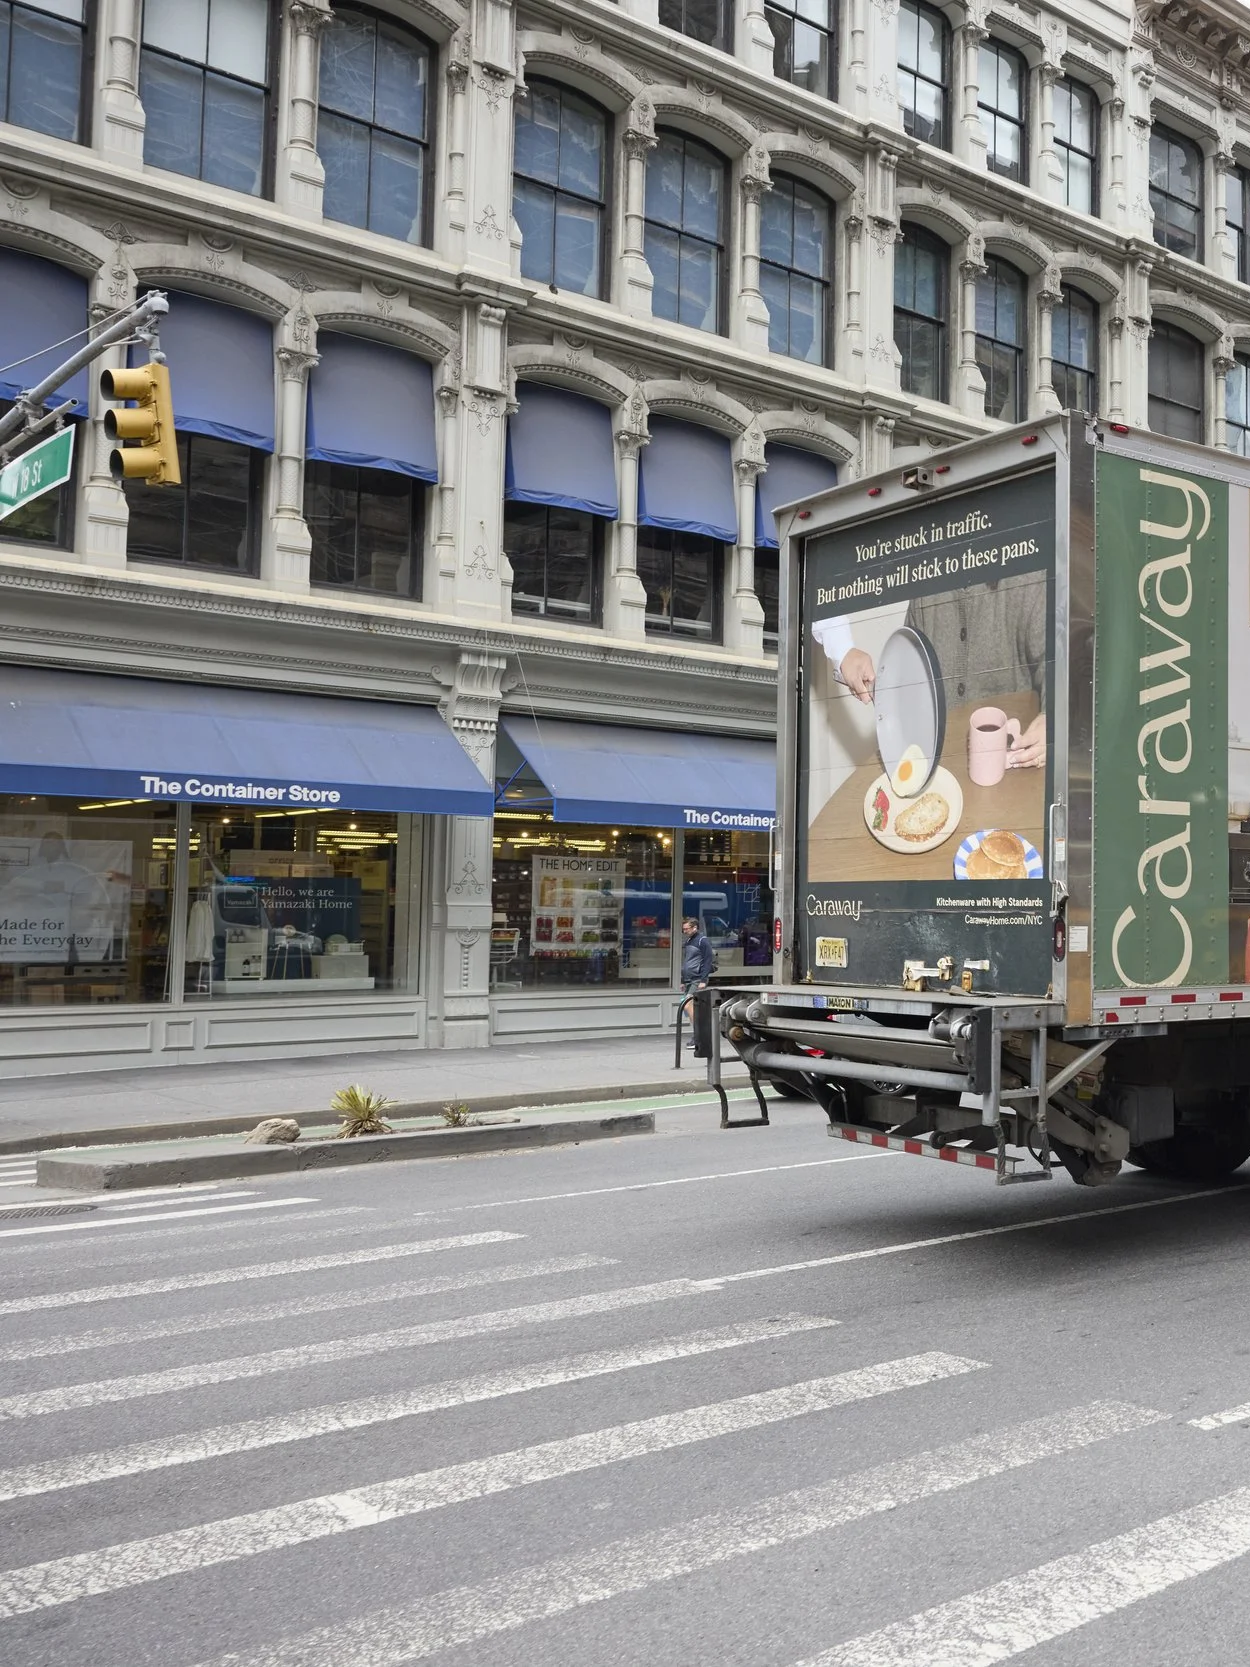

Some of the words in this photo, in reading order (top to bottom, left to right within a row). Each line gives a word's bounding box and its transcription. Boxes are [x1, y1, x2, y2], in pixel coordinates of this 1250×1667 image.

[20, 466, 30, 494] 18
[31, 459, 43, 487] St
[854, 538, 892, 563] You're
[894, 526, 928, 552] stuck
[931, 523, 944, 543] in
[946, 510, 992, 538] traffic.
[816, 587, 837, 606] But
[838, 574, 884, 600] nothing
[886, 566, 909, 588] will
[911, 558, 943, 583] stick
[945, 556, 959, 573] to
[962, 547, 998, 570] these
[1001, 538, 1040, 566] pans.
[1112, 468, 1211, 988] Caraway
[140, 776, 182, 795] The
[184, 779, 287, 800] Container
[289, 785, 341, 803] Store
[683, 809, 710, 824] The
[711, 811, 776, 827] Container
[540, 858, 559, 870] THE
[562, 859, 594, 871] HOME
[596, 861, 620, 872] EDIT
[261, 886, 296, 898] Hello,
[298, 889, 315, 897] we
[317, 888, 335, 897] are
[261, 899, 316, 909] Yamazaki
[319, 899, 353, 909] Home
[806, 894, 862, 921] Caraway
[936, 897, 975, 907] Kitchenware
[976, 897, 991, 907] with
[992, 897, 1007, 908] High
[1008, 897, 1043, 907] Standards
[0, 919, 38, 931] Made
[41, 918, 65, 931] for
[964, 914, 1043, 927] CarawayHome.com/NYC
[0, 934, 18, 946] he
[23, 933, 94, 949] Everyday
[828, 997, 851, 1008] MAXON
